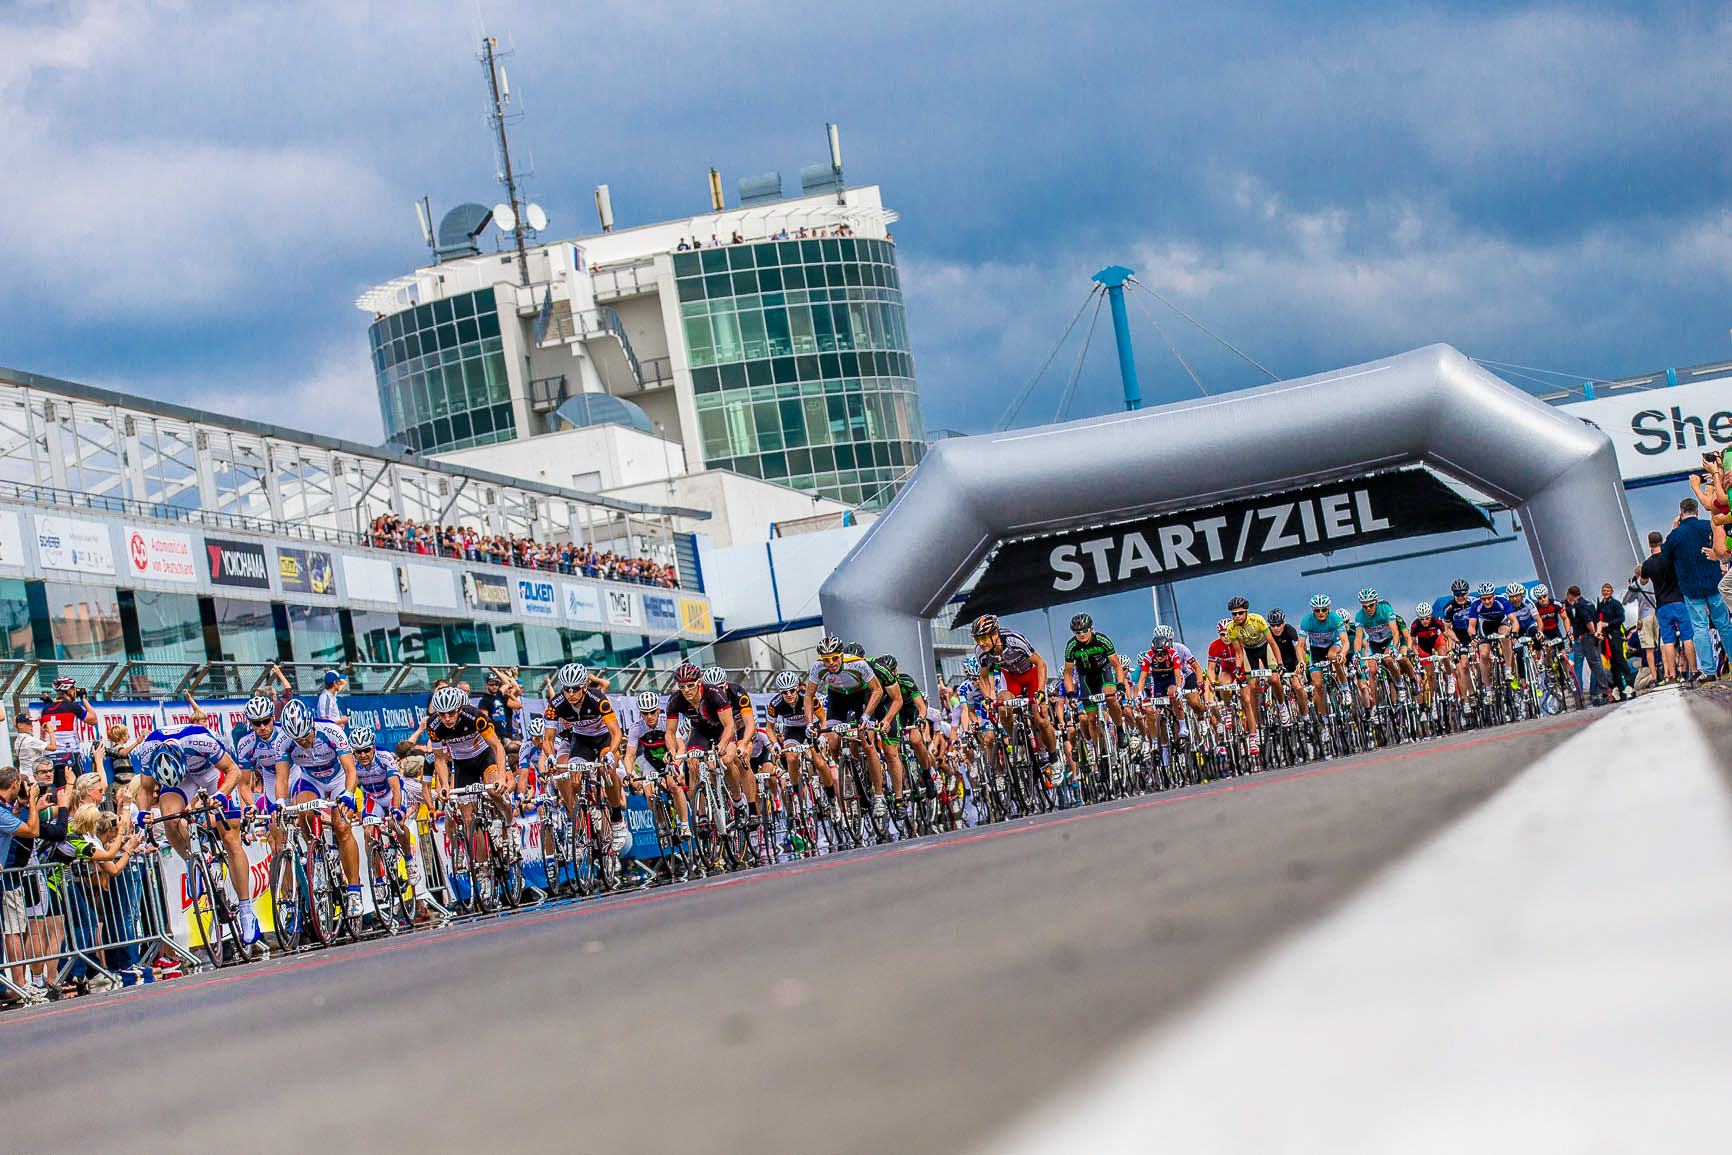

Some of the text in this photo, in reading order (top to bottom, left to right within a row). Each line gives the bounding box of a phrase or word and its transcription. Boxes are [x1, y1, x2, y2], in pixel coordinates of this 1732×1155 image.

[1049, 490, 1390, 592] START/ZIEL
[220, 549, 267, 580] YOKOHAMA
[519, 581, 554, 602] FALKEN
[189, 740, 214, 748] FOCUS
[322, 727, 345, 742] FOCUS
